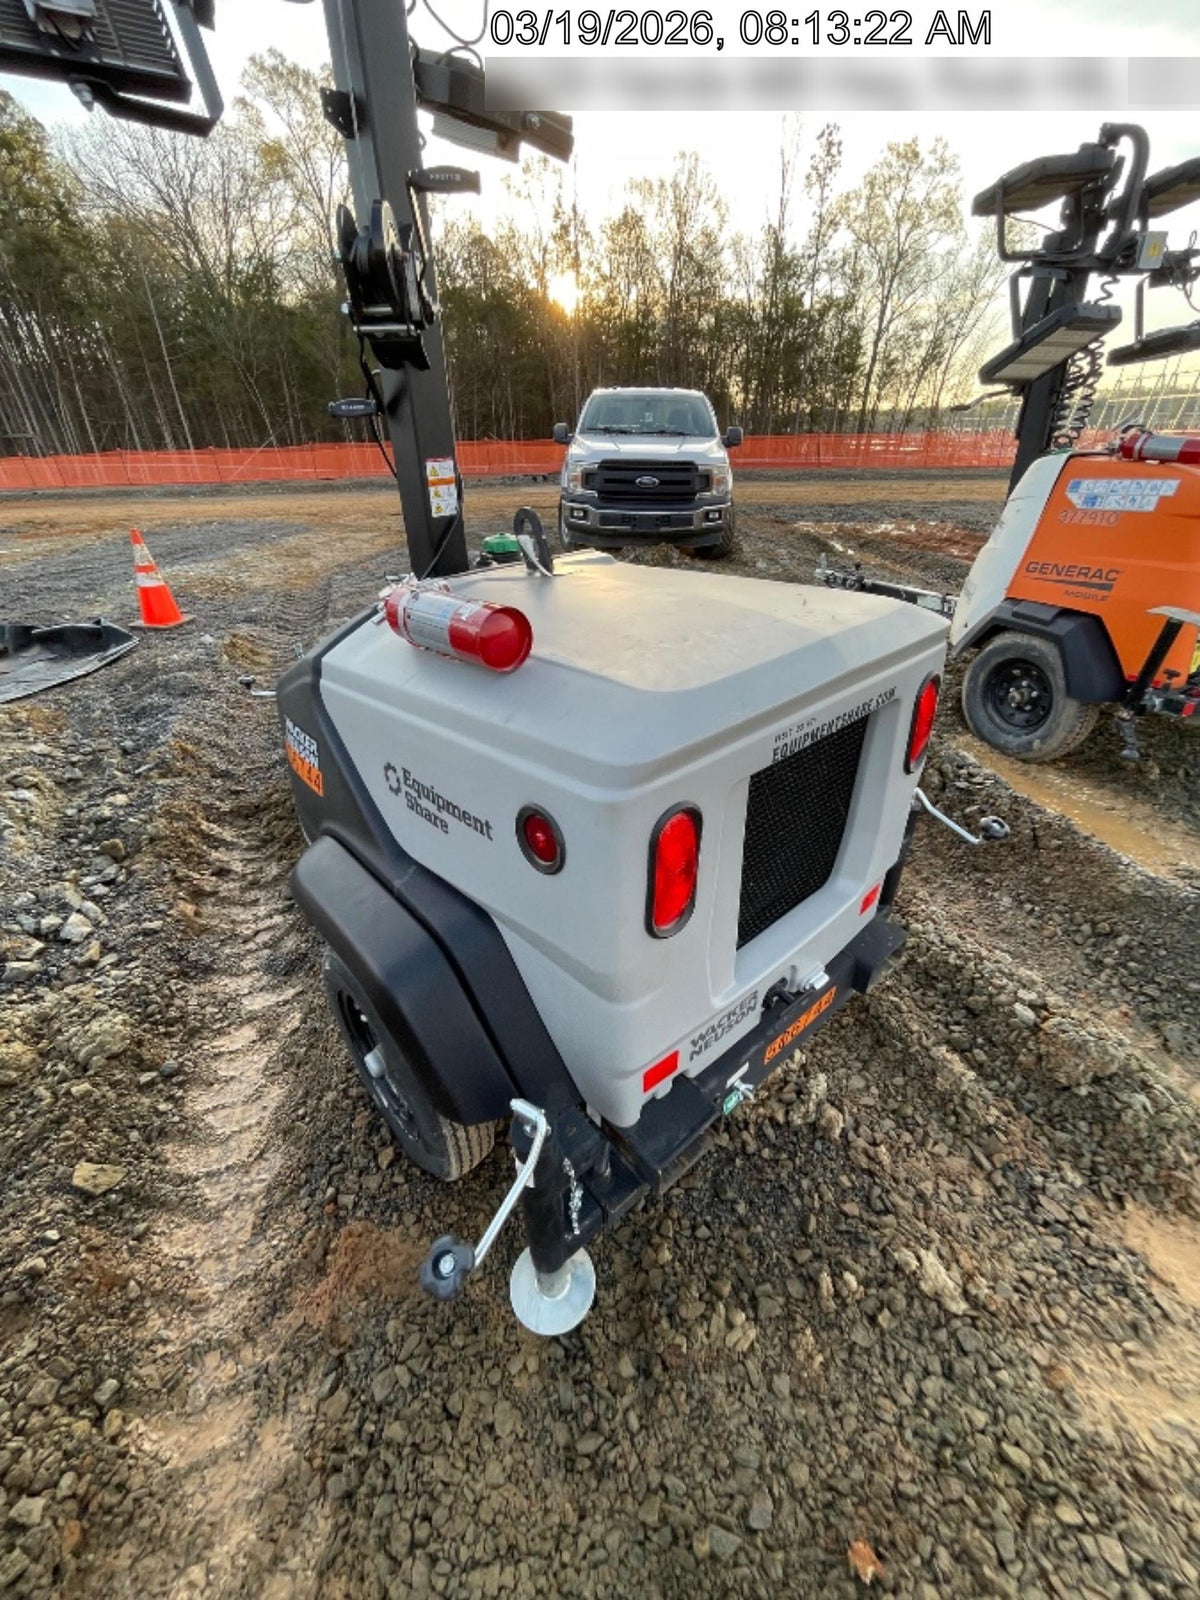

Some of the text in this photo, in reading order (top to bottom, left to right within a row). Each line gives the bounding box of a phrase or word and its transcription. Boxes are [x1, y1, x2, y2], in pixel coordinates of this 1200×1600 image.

[1025, 561, 1121, 582] GENERAC
[772, 686, 898, 763] EQUIPMENTSHARE.COM
[401, 766, 494, 842] Equipment
[404, 790, 450, 835] Share
[689, 1004, 759, 1062] NEUSON
[690, 989, 759, 1048] WACKER
